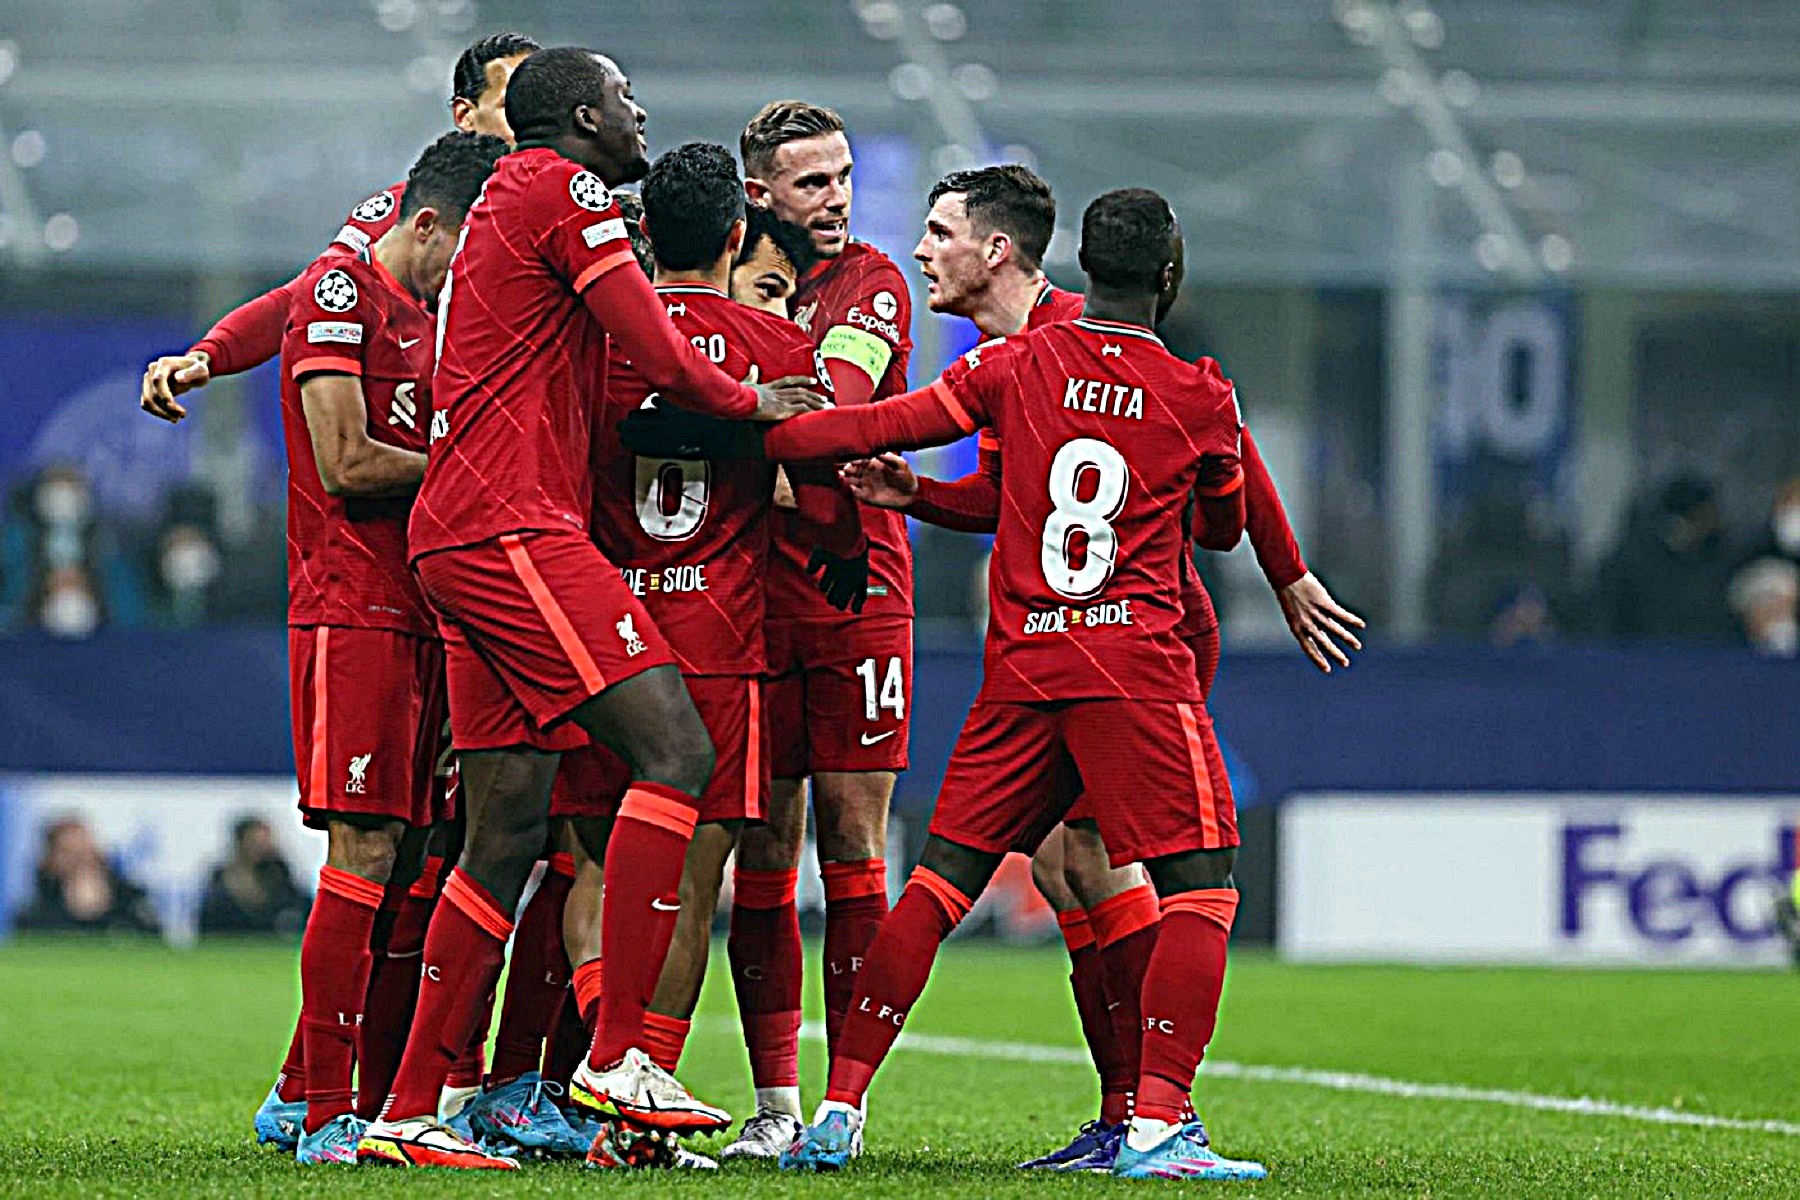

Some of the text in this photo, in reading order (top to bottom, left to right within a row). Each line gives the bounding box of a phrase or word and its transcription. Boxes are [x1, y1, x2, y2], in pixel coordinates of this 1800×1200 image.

[1063, 377, 1143, 420] KEITA
[1041, 438, 1129, 600] 8
[663, 564, 709, 593] SIDE
[1024, 606, 1069, 634] SIDE
[1085, 599, 1133, 627] SIDE
[856, 657, 905, 720] 14
[345, 783, 367, 795] LFC
[1564, 825, 1796, 943] Fed
[859, 997, 904, 1025] LFC
[1143, 1017, 1174, 1034] FC
